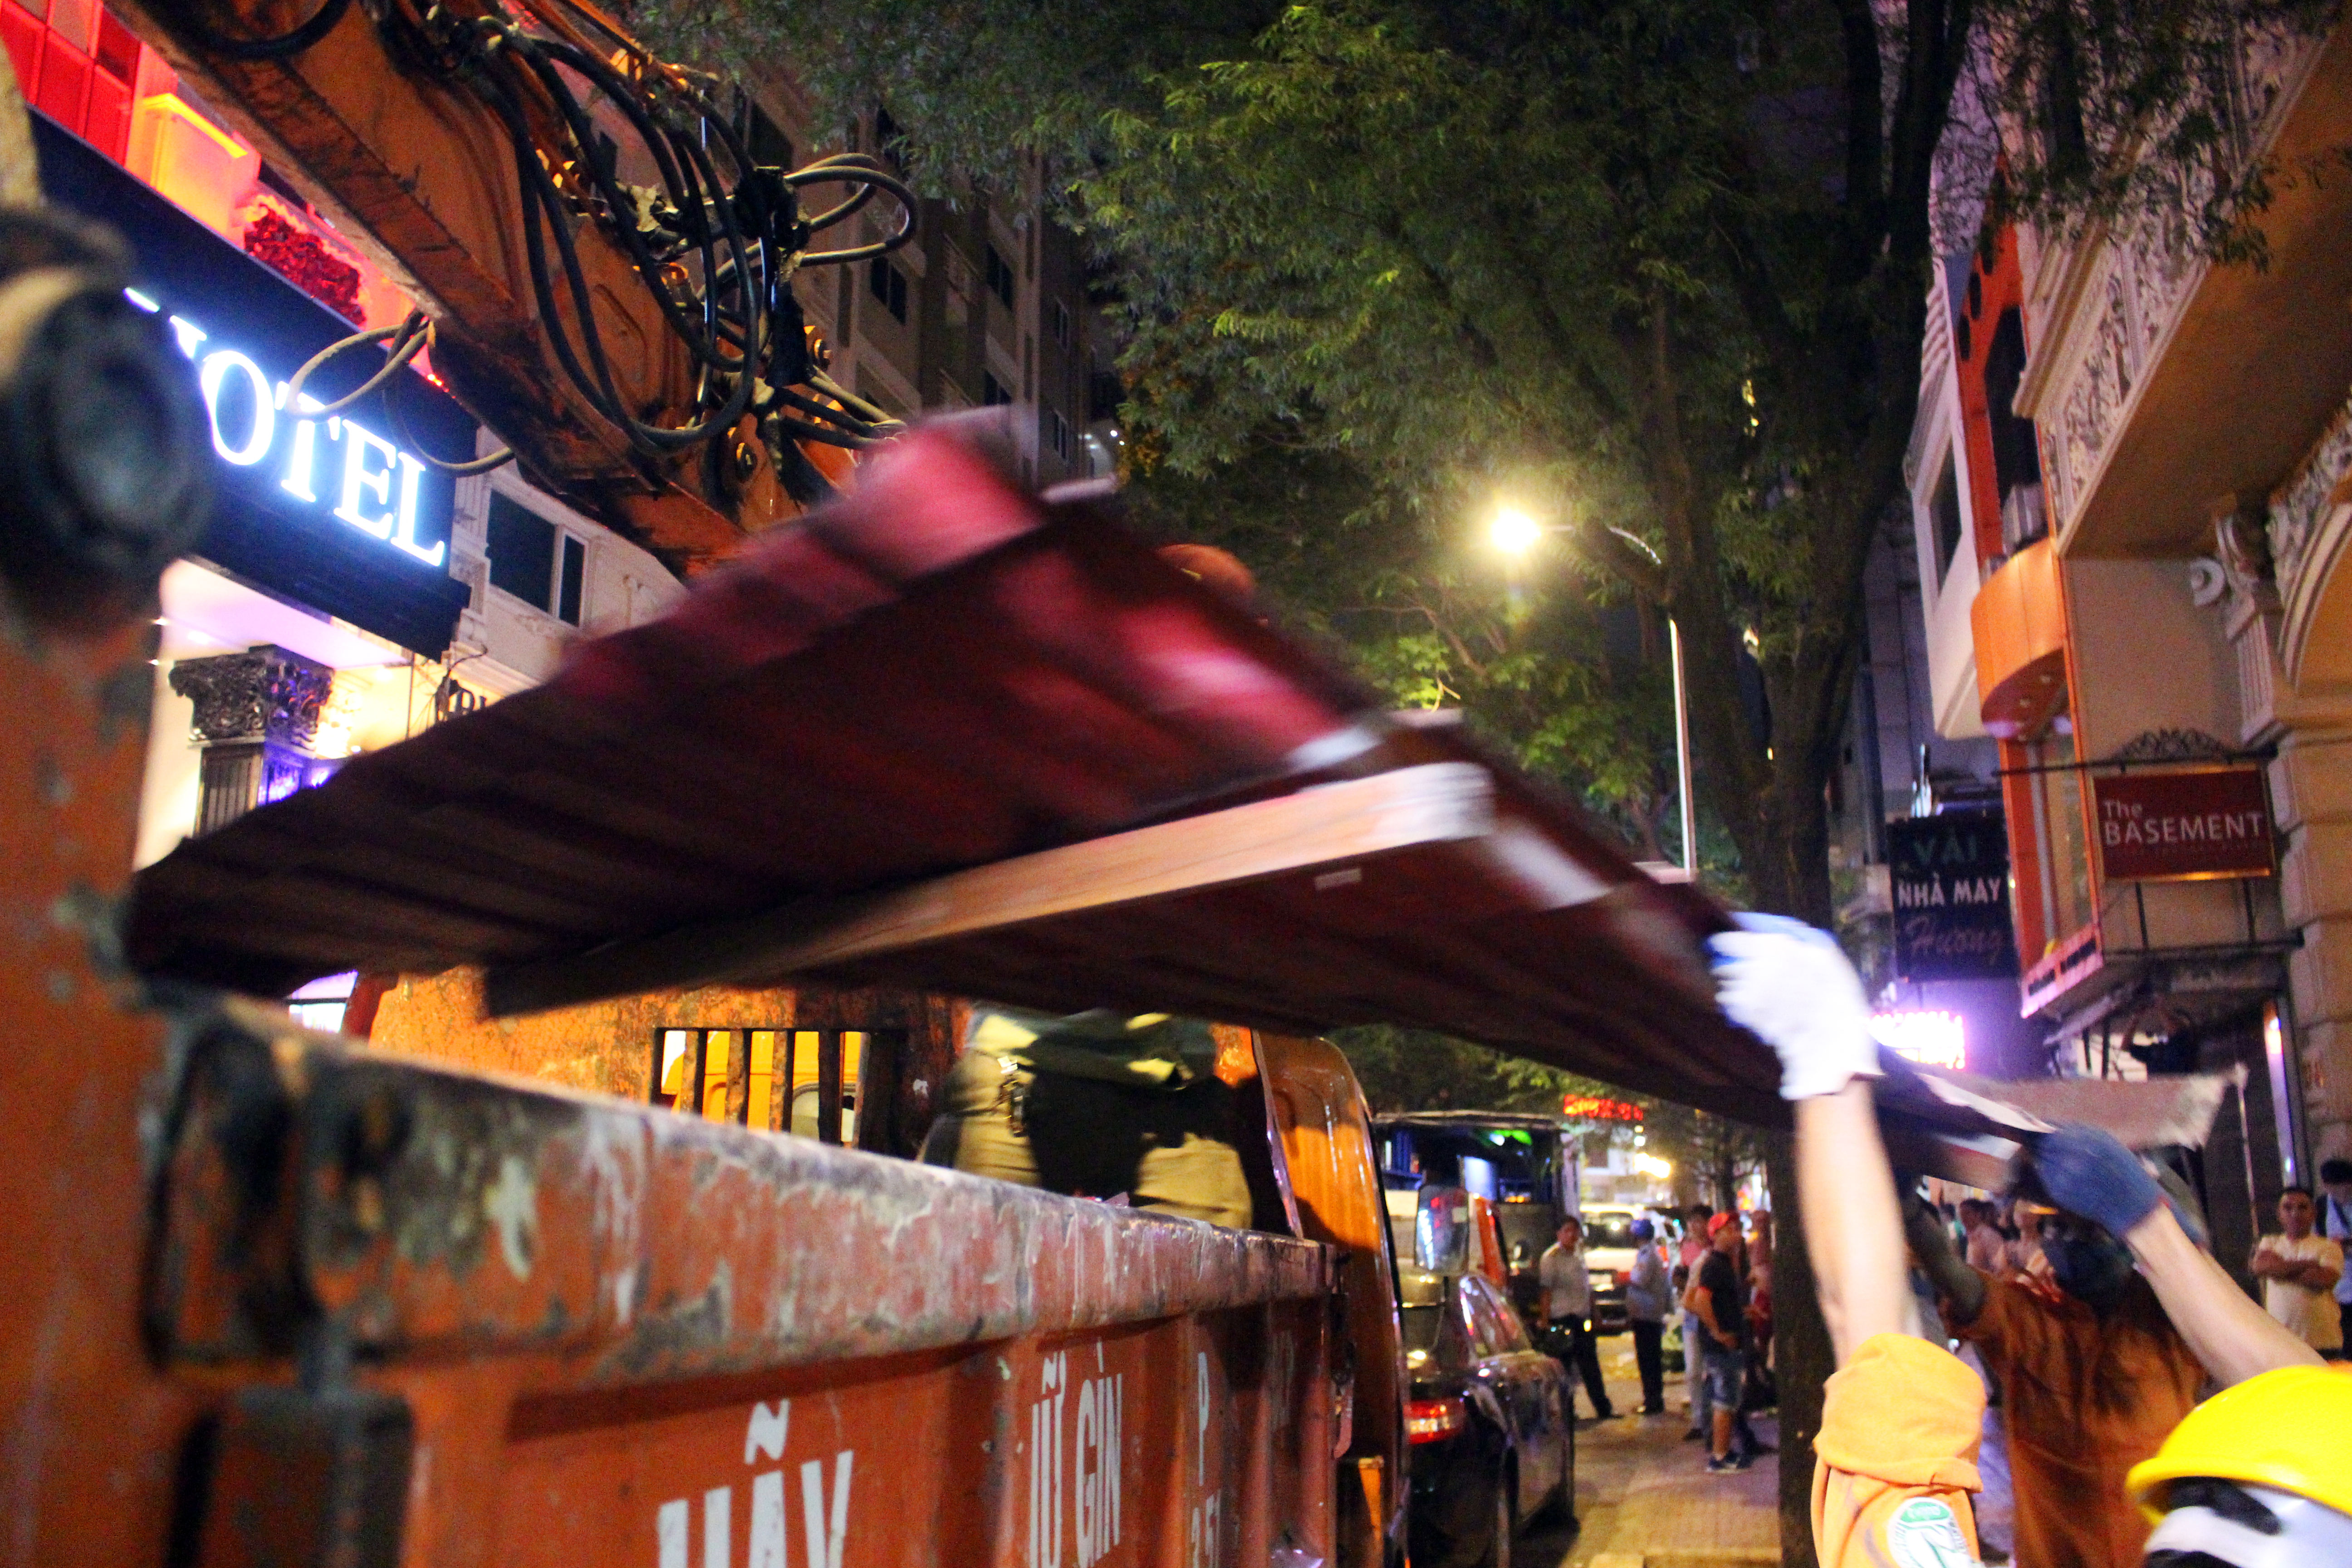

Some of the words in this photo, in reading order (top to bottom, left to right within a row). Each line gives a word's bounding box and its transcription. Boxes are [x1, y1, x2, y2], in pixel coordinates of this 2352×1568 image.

[2104, 799, 2143, 818] The
[2104, 811, 2264, 847] BASEMENT
[1898, 872, 1945, 907] NHÀ
[1953, 877, 2002, 905] MAY
